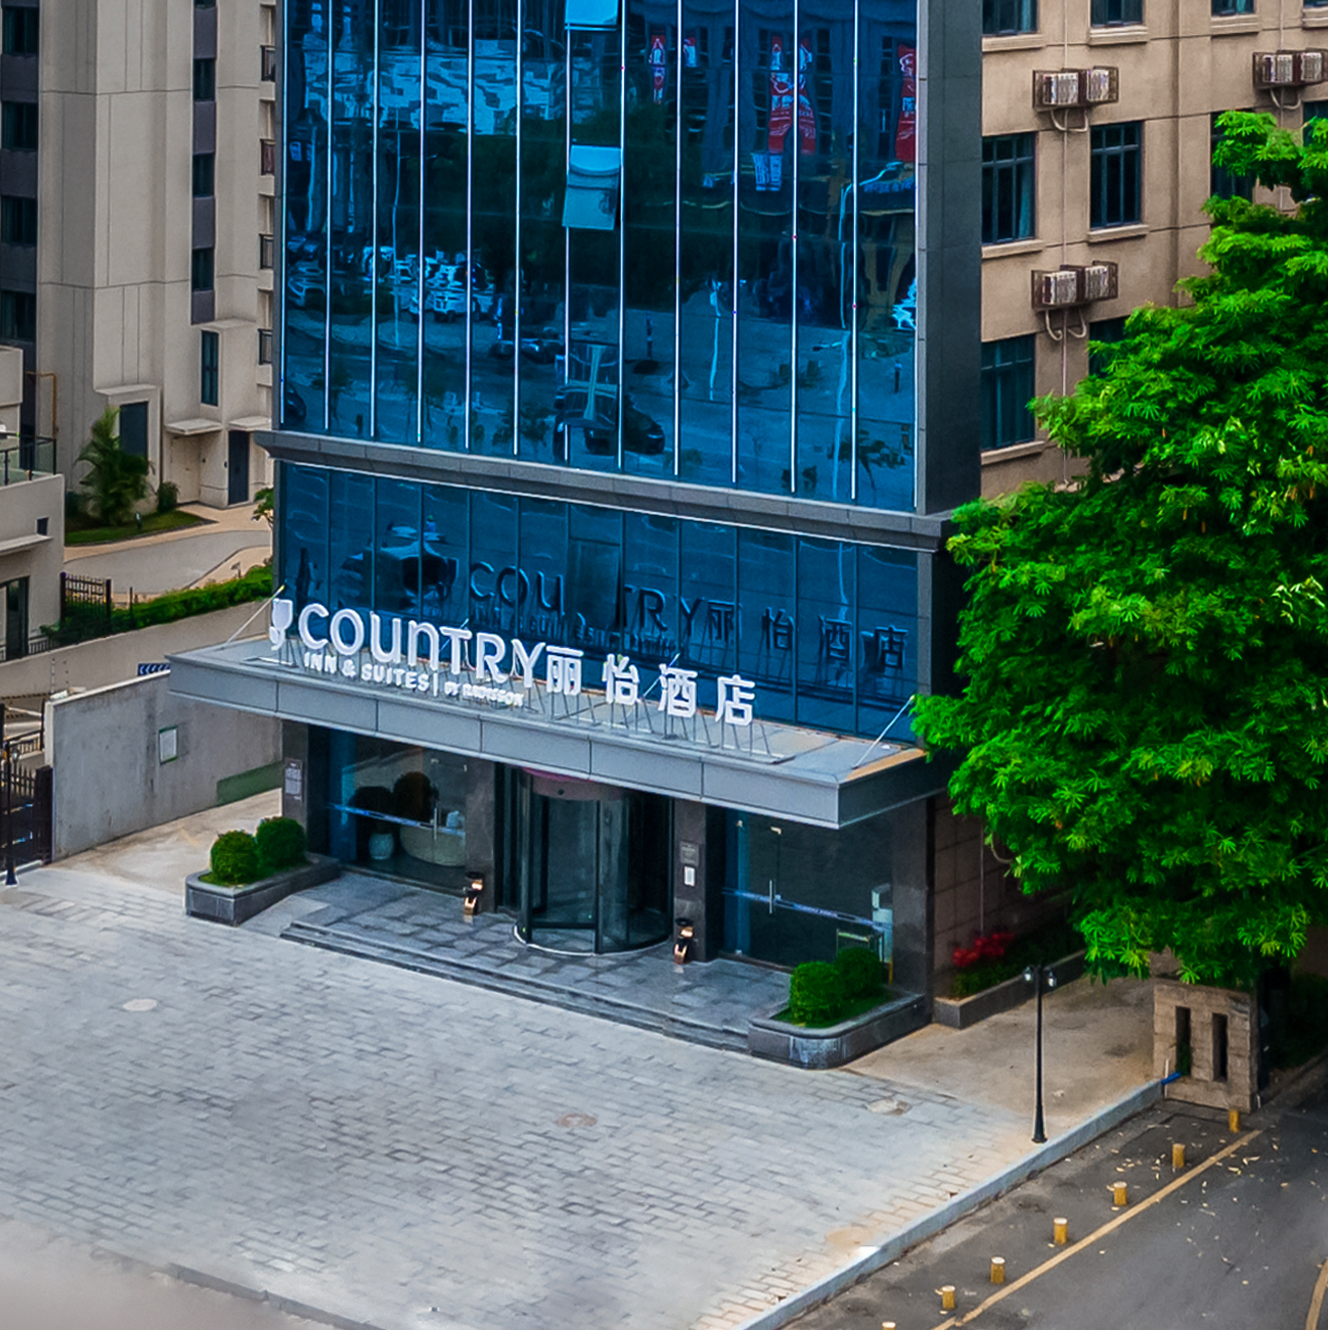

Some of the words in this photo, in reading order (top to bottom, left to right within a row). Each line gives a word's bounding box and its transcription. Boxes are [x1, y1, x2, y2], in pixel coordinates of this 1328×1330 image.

[304, 651, 337, 674] INN
[342, 659, 357, 678] &
[361, 663, 430, 691] SUITES
[545, 644, 755, 726] 丽怡酒店
